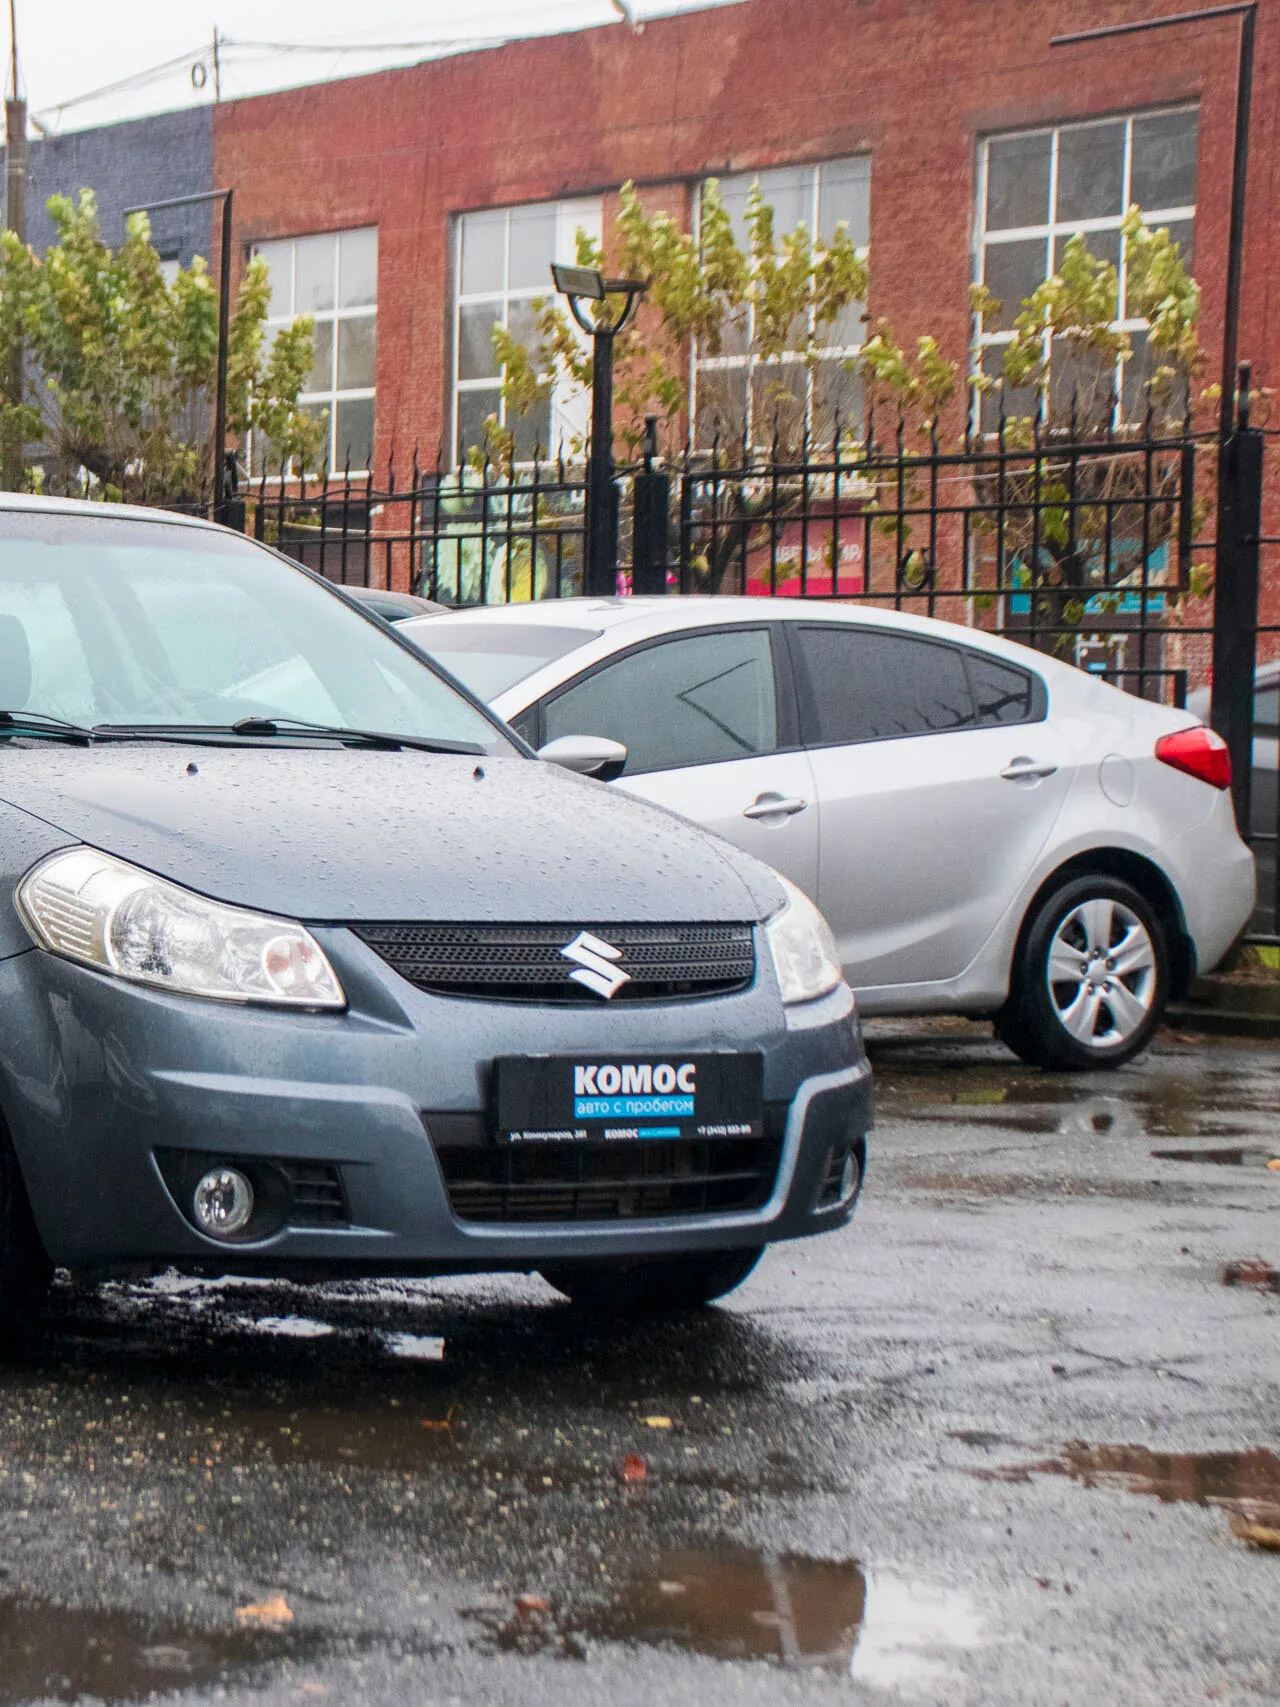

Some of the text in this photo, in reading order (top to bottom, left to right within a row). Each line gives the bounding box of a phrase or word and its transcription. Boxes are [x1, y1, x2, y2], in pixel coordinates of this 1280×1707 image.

[574, 1063, 696, 1094] КОМОС
[577, 1099, 694, 1115] авто с пробегом
[604, 1128, 639, 1140] КОМОС
